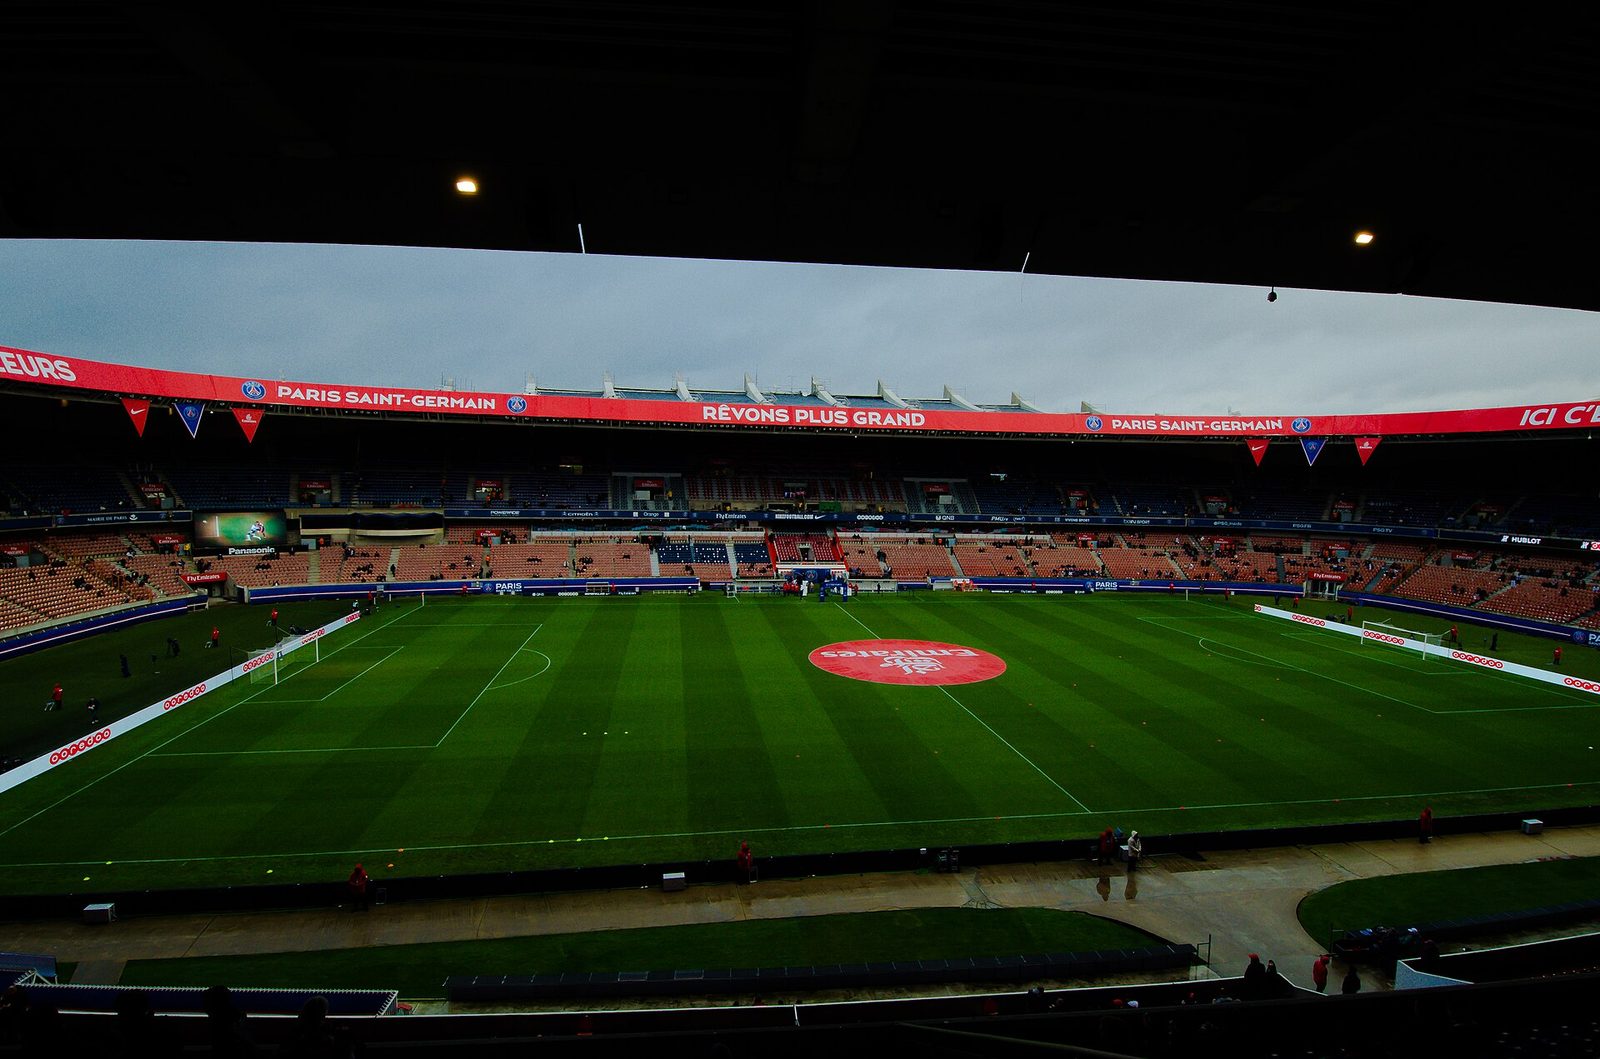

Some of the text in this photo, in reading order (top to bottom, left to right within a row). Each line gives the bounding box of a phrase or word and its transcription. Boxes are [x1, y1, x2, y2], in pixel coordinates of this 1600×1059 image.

[0, 351, 76, 381] EURS
[277, 385, 341, 403] PARIS
[344, 389, 495, 411] SAINT-GERMAIN
[703, 404, 925, 427] RÊVONS PLUS GRAND
[1519, 408, 1558, 426] ICI
[1111, 419, 1156, 431] PARIS
[1159, 419, 1283, 432] SAINT-GERMAIN
[1511, 536, 1542, 545] HUBLOT
[228, 545, 276, 555] Panasonic
[495, 582, 523, 590] PARIS
[1363, 630, 1405, 645] ooredoo
[242, 652, 274, 672] ooredoo
[820, 648, 980, 658] Emirates
[1452, 650, 1503, 669] ooredoo
[163, 683, 206, 711] ooredoo
[49, 728, 111, 765] ooredoo
